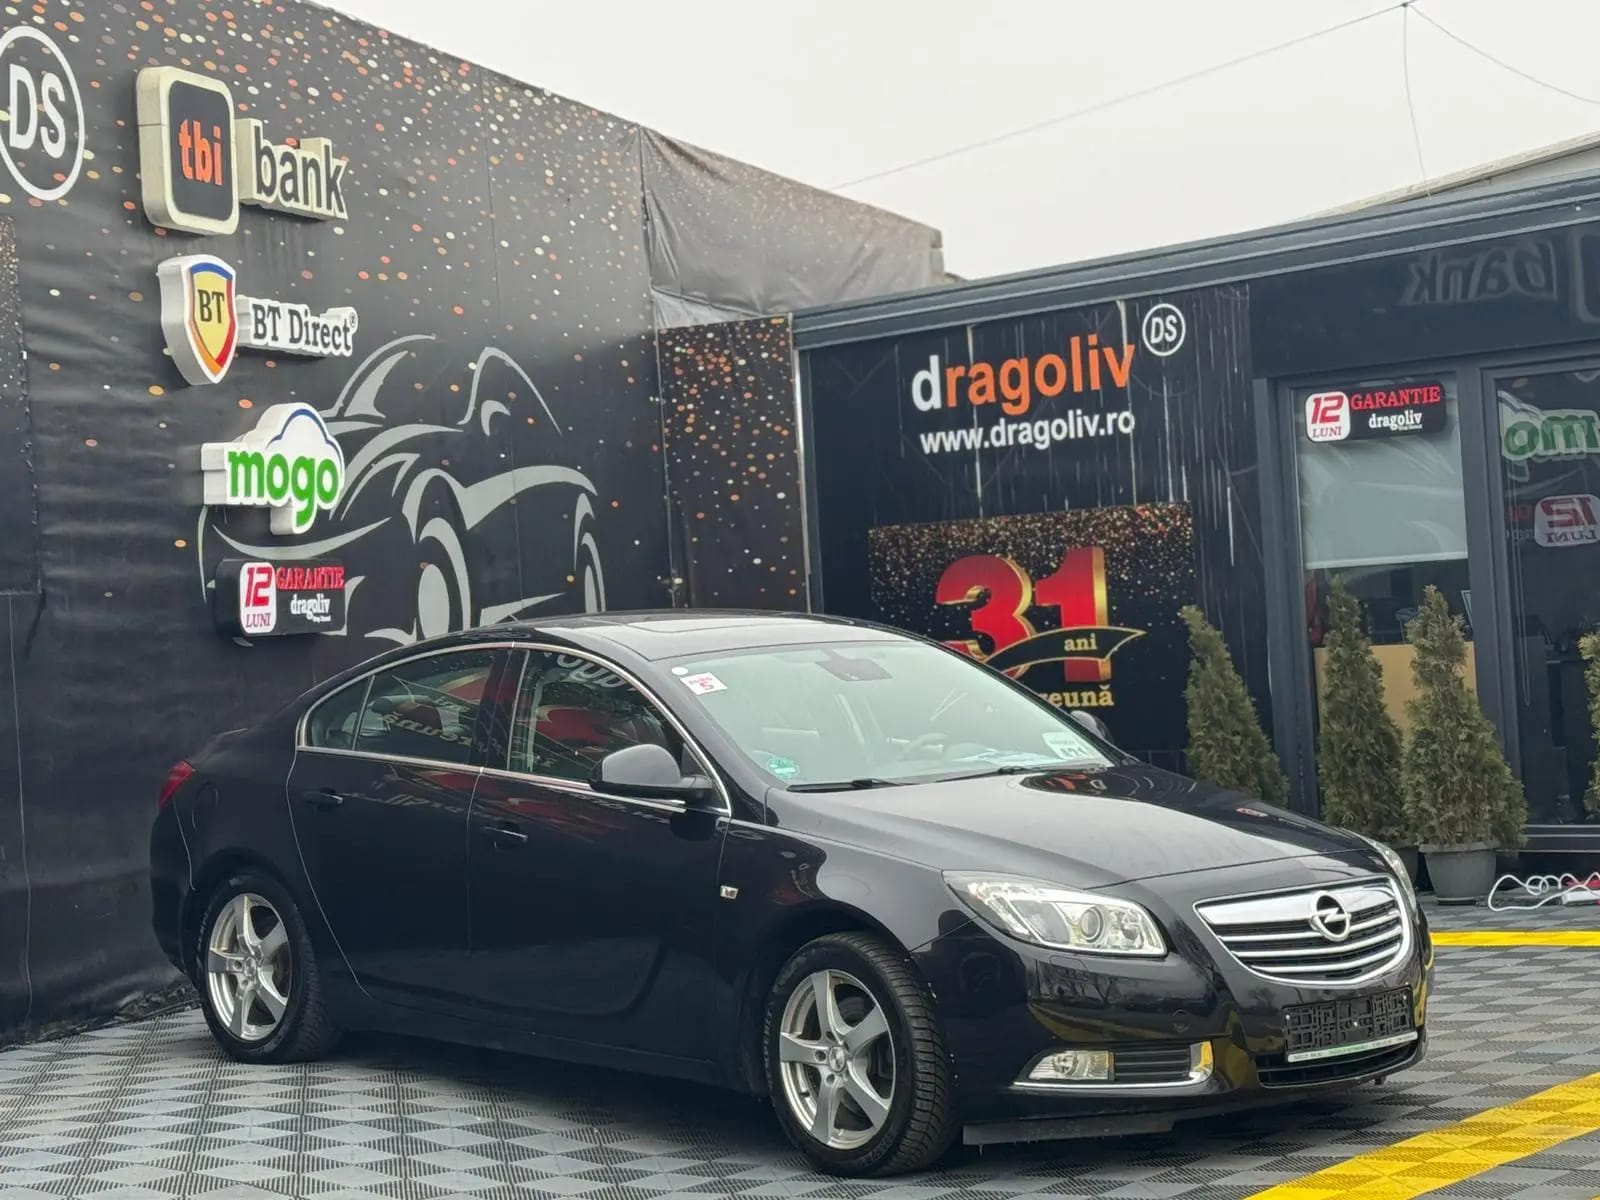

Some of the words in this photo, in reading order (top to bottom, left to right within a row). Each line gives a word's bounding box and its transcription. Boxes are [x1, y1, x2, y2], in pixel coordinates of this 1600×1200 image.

[9, 63, 66, 159] DS
[179, 119, 223, 186] tbi
[252, 121, 347, 218] bank
[198, 289, 225, 324] BT
[252, 304, 281, 342] BT
[1151, 315, 1177, 344] DS
[911, 334, 1135, 416] dragoliv
[1311, 395, 1344, 425] 12
[1350, 386, 1440, 410] GARANTIE
[920, 408, 1135, 455] www.dragoliv.ro
[1312, 426, 1342, 438] LUNI
[1368, 409, 1422, 431] dragoliv
[228, 451, 339, 527] mogo
[244, 566, 273, 608] 12
[276, 566, 345, 590] GARANTIE
[245, 613, 271, 628] LUNI
[290, 593, 331, 620] dragoliv
[935, 546, 1112, 682] 31
[1063, 633, 1097, 651] ani
